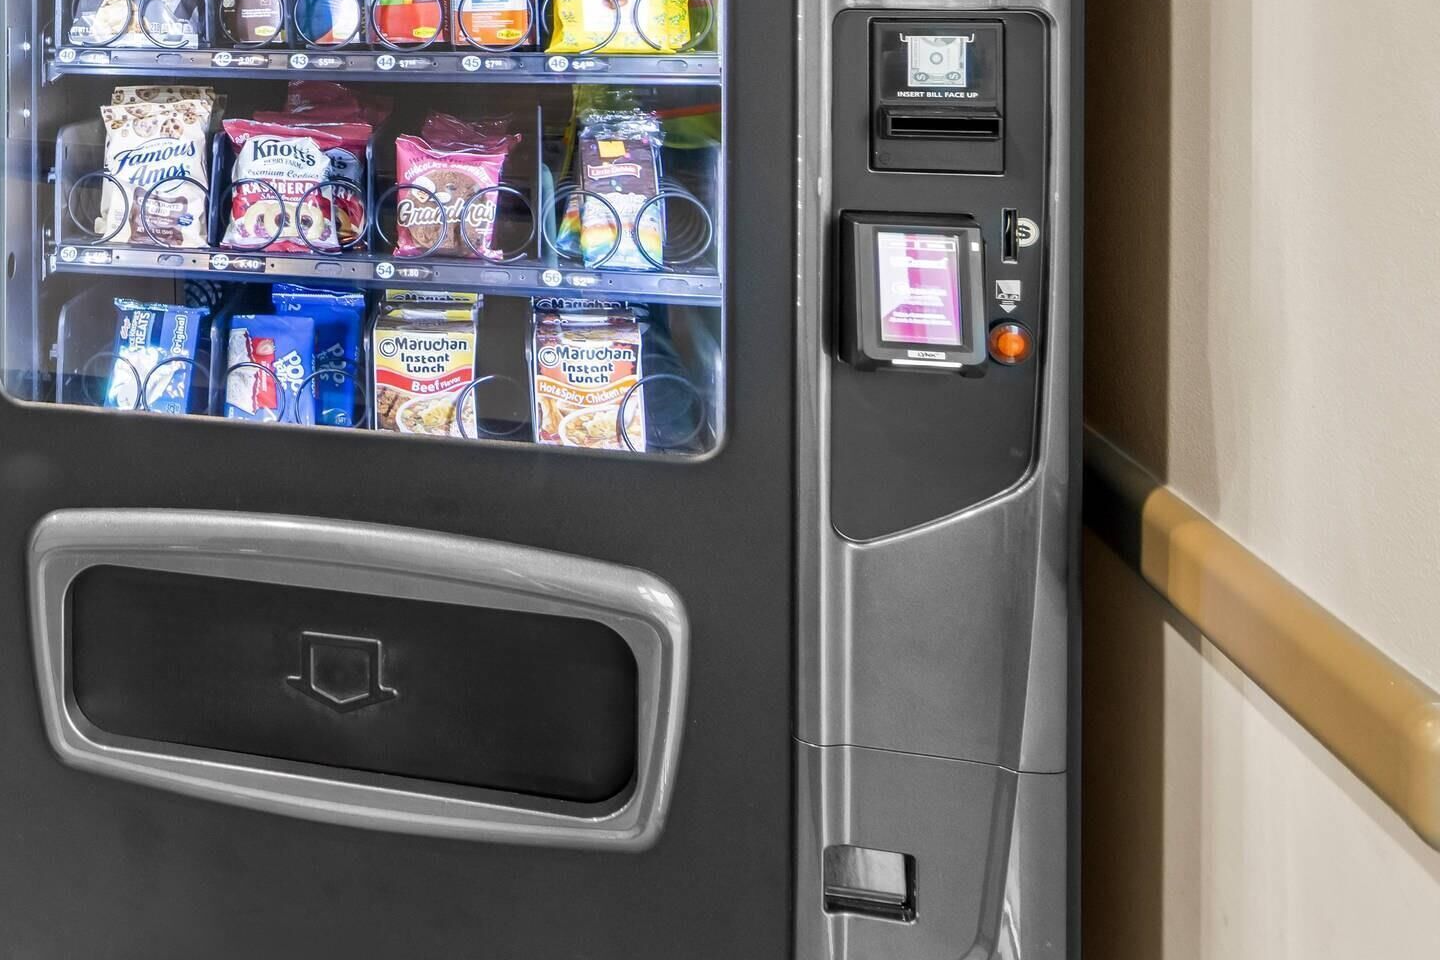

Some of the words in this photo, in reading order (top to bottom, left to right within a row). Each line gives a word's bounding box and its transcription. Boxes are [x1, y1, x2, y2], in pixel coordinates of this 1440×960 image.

[61, 50, 74, 60] 40
[292, 55, 306, 65] 43
[378, 58, 393, 67] 44
[464, 59, 479, 68] 45
[551, 59, 566, 68] 46
[114, 140, 196, 176] Famous
[253, 139, 316, 167] Knott's
[129, 162, 189, 186] Amos
[63, 249, 76, 259] 50
[378, 265, 392, 275] 54
[545, 272, 560, 283] 56
[136, 312, 151, 349] TREATS
[172, 315, 187, 354] Original
[395, 337, 467, 351] Maruchan
[401, 353, 449, 363] Instant
[557, 347, 632, 360] Maruchan
[407, 364, 445, 373] Lunch
[563, 363, 613, 373] Instant
[569, 374, 609, 383] Lunch
[412, 380, 440, 393] Beef
[440, 377, 461, 389] Flavor
[540, 383, 555, 394] Hot
[562, 388, 585, 403] Spicy
[586, 388, 620, 403] Chicken
